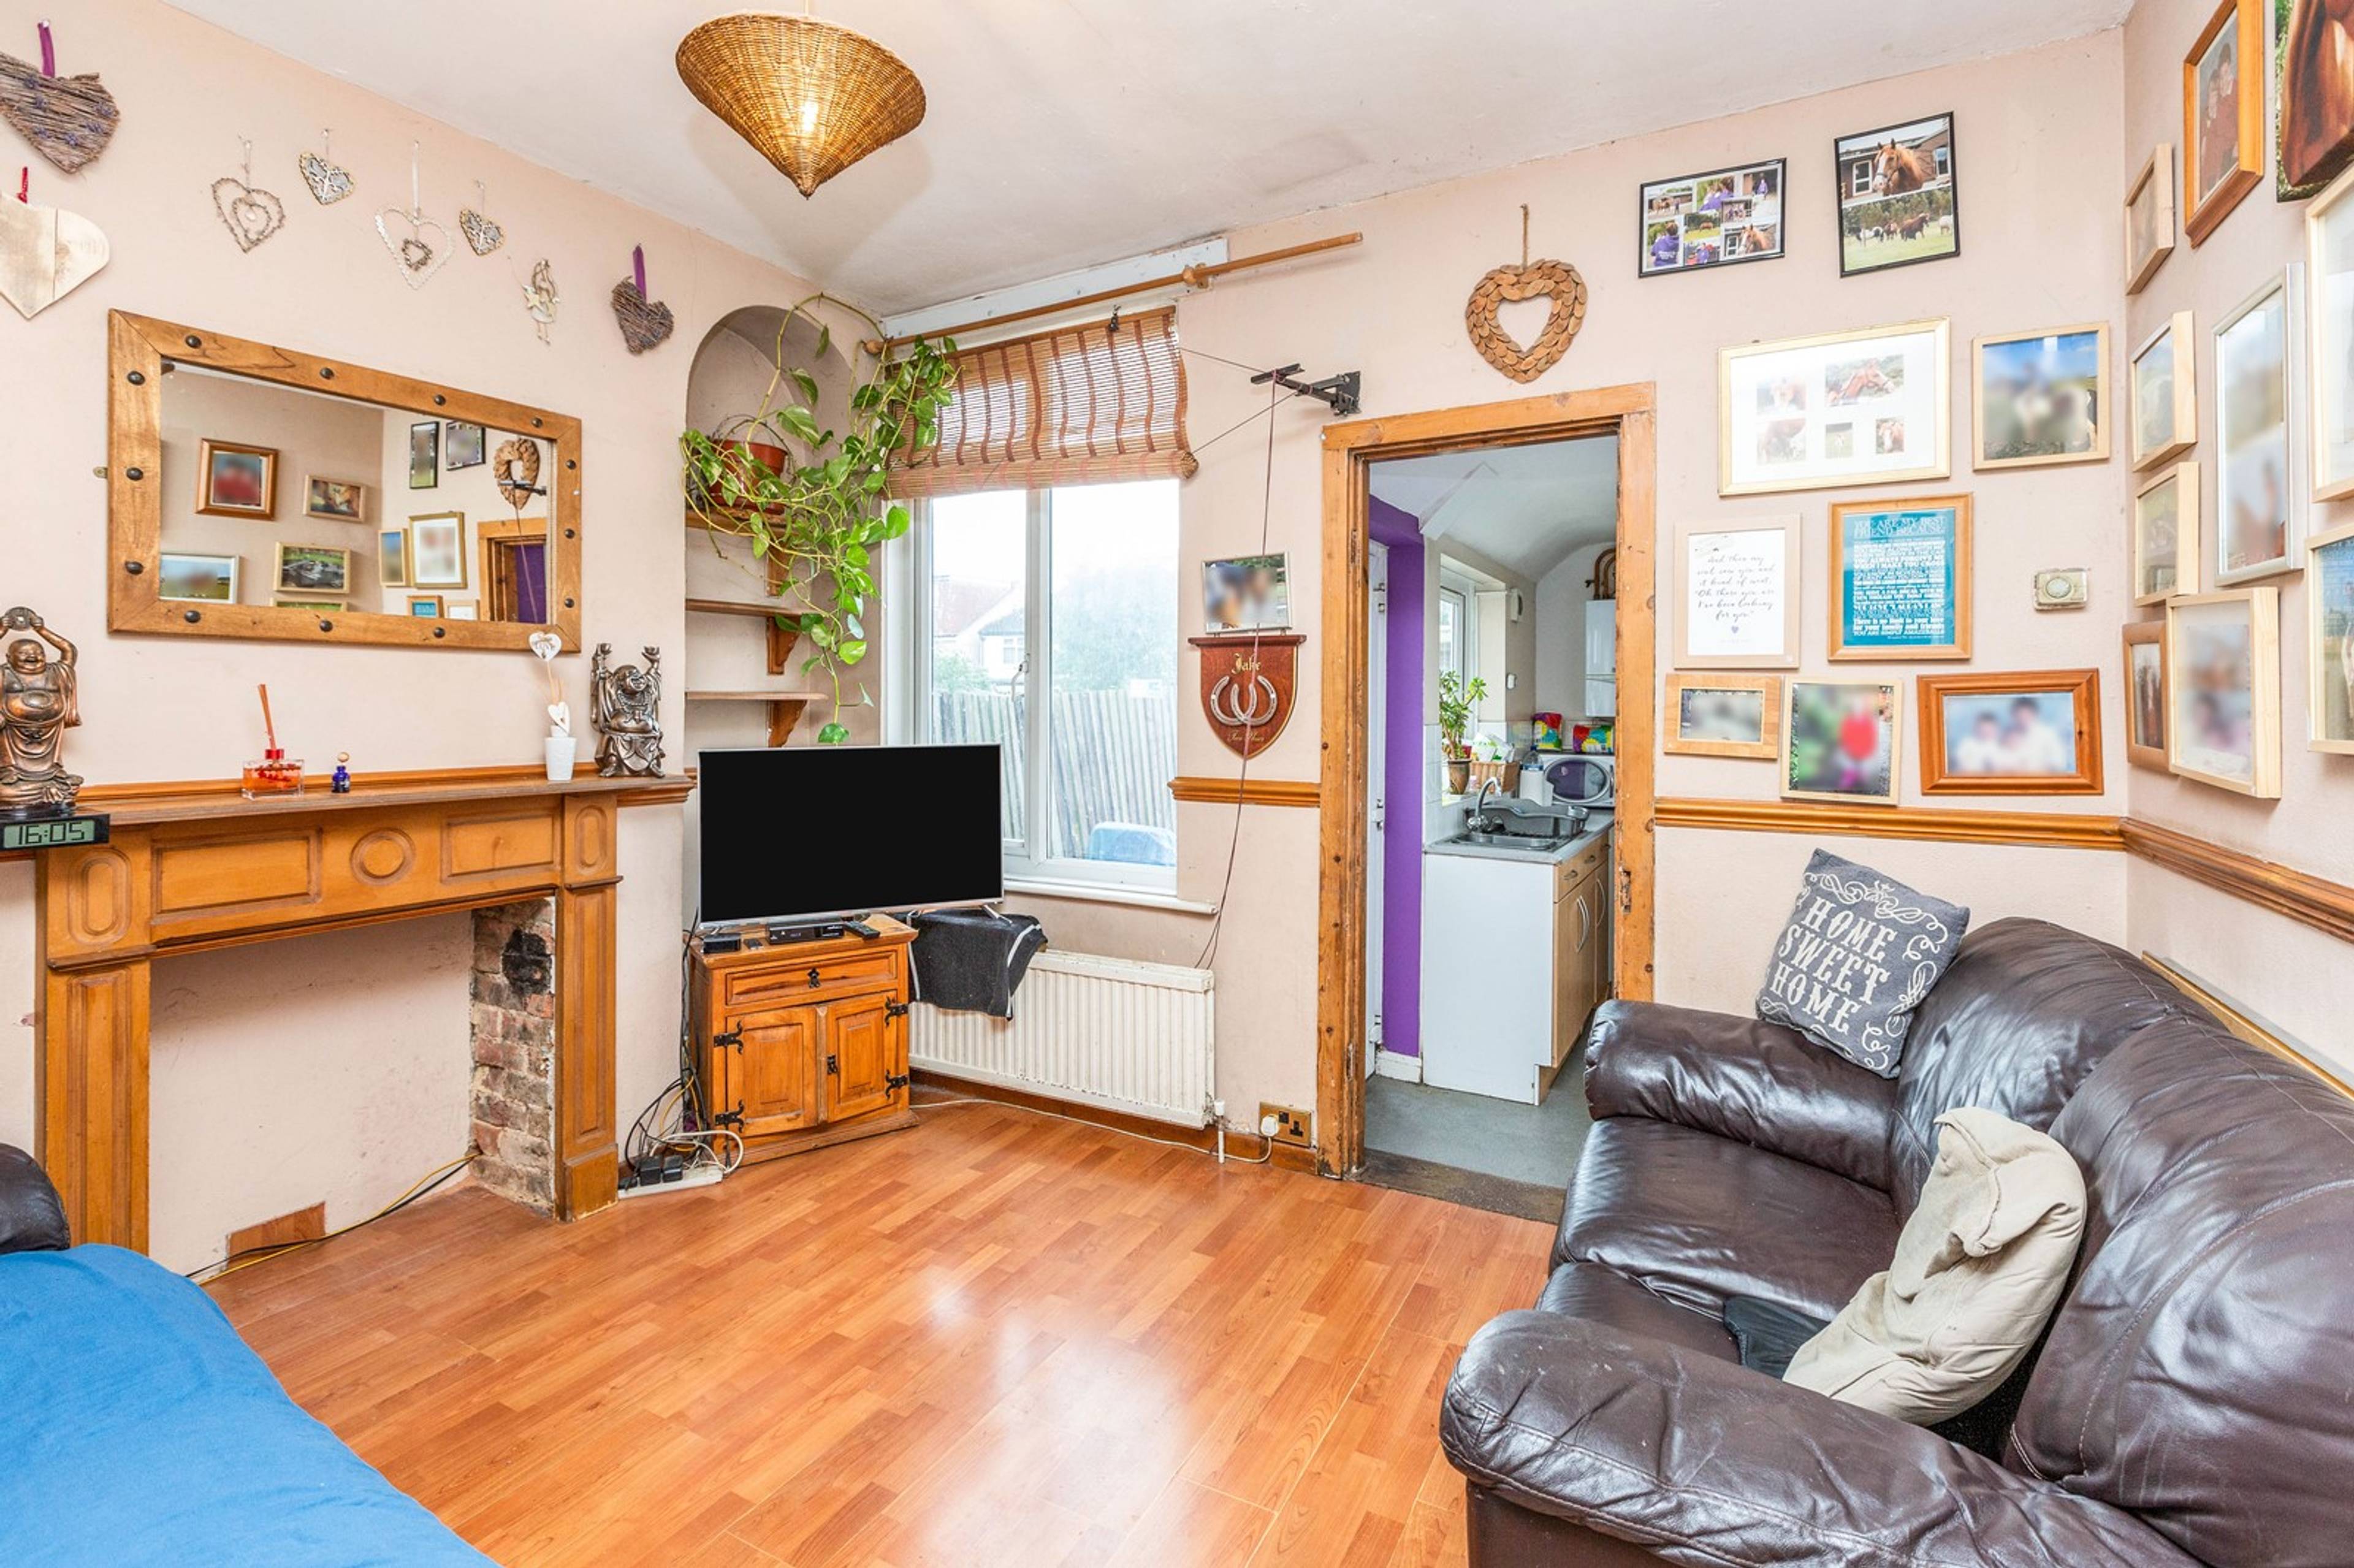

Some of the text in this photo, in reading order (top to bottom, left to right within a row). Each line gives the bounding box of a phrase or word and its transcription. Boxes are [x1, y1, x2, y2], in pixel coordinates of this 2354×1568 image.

[18, 821, 85, 845] 16:05
[1801, 896, 1898, 962] HOME
[1770, 961, 1862, 1035] HOME
[1778, 924, 1891, 1005] SWEET
